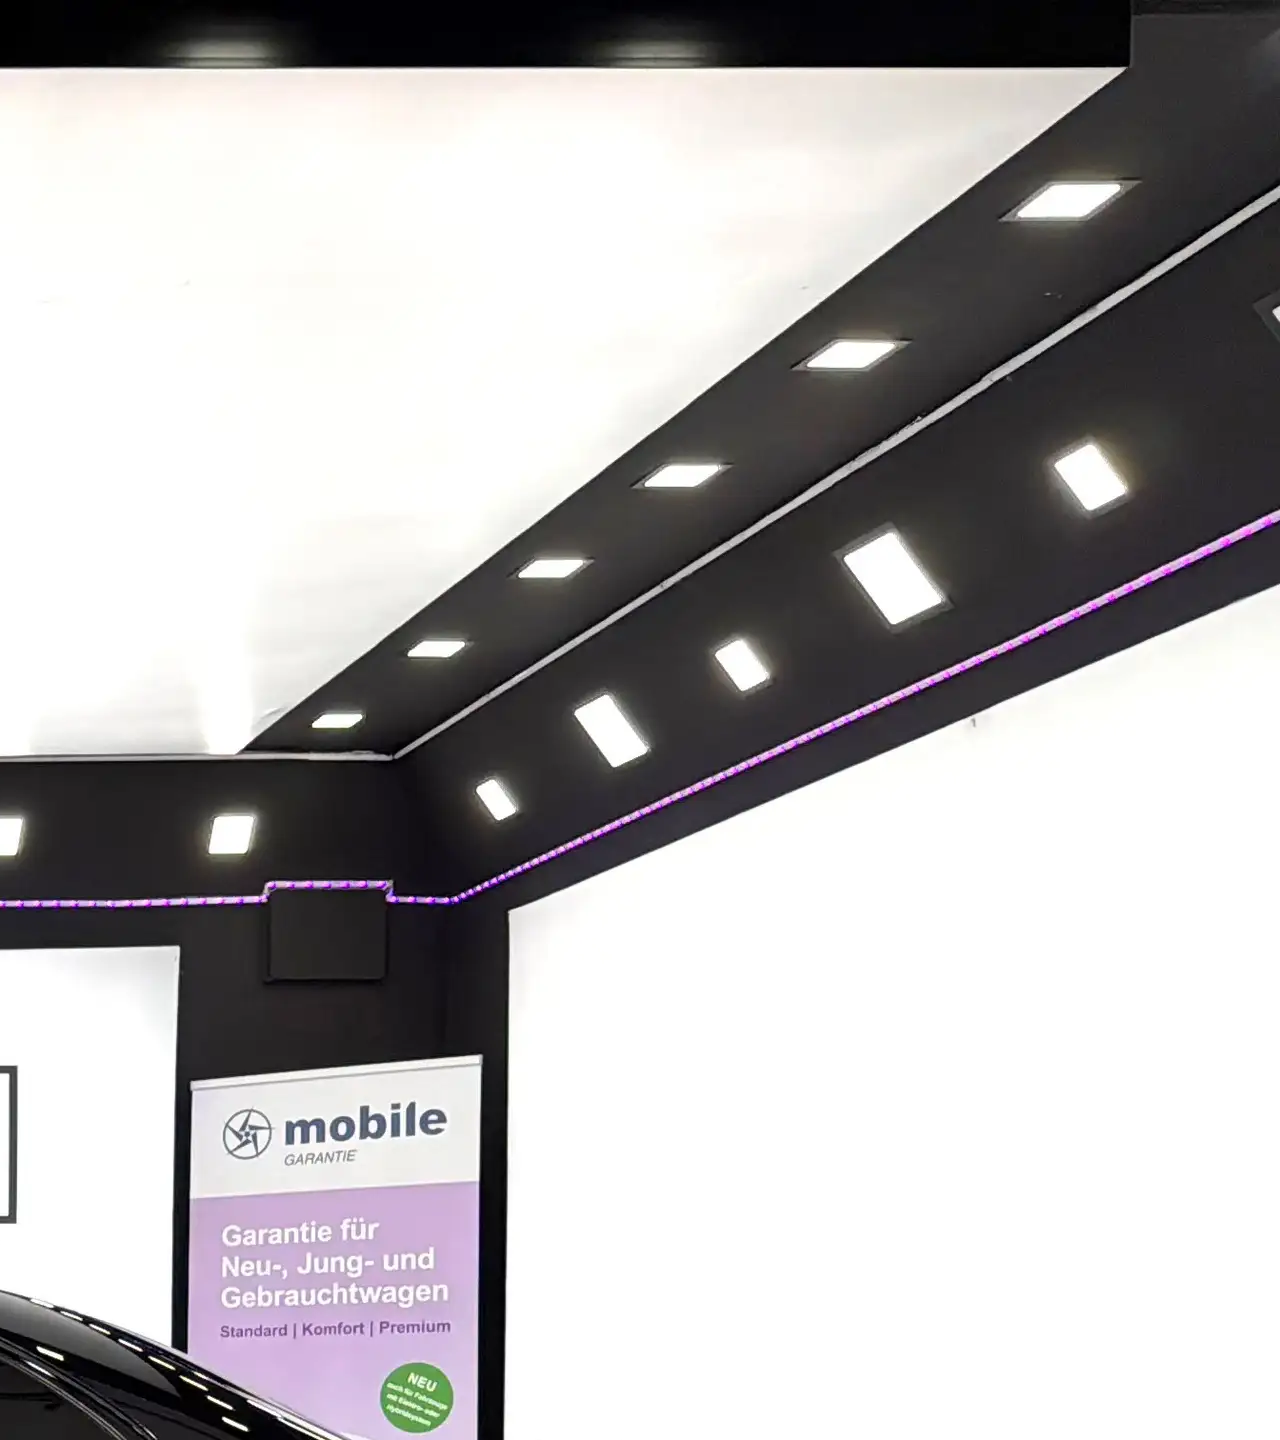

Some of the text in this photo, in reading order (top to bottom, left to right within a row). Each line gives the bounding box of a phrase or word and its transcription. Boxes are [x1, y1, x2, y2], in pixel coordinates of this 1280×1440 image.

[285, 1102, 447, 1145] mobile
[284, 1149, 357, 1166] GARANTIE
[222, 1218, 379, 1247] Garantie für
[221, 1247, 434, 1279] Neu-, Jung- und
[221, 1283, 449, 1308] Gebrauchtwagen
[220, 1324, 288, 1338] Standard
[302, 1321, 365, 1336] Komfort
[379, 1319, 451, 1335] Premium
[407, 1372, 438, 1392] NEU
